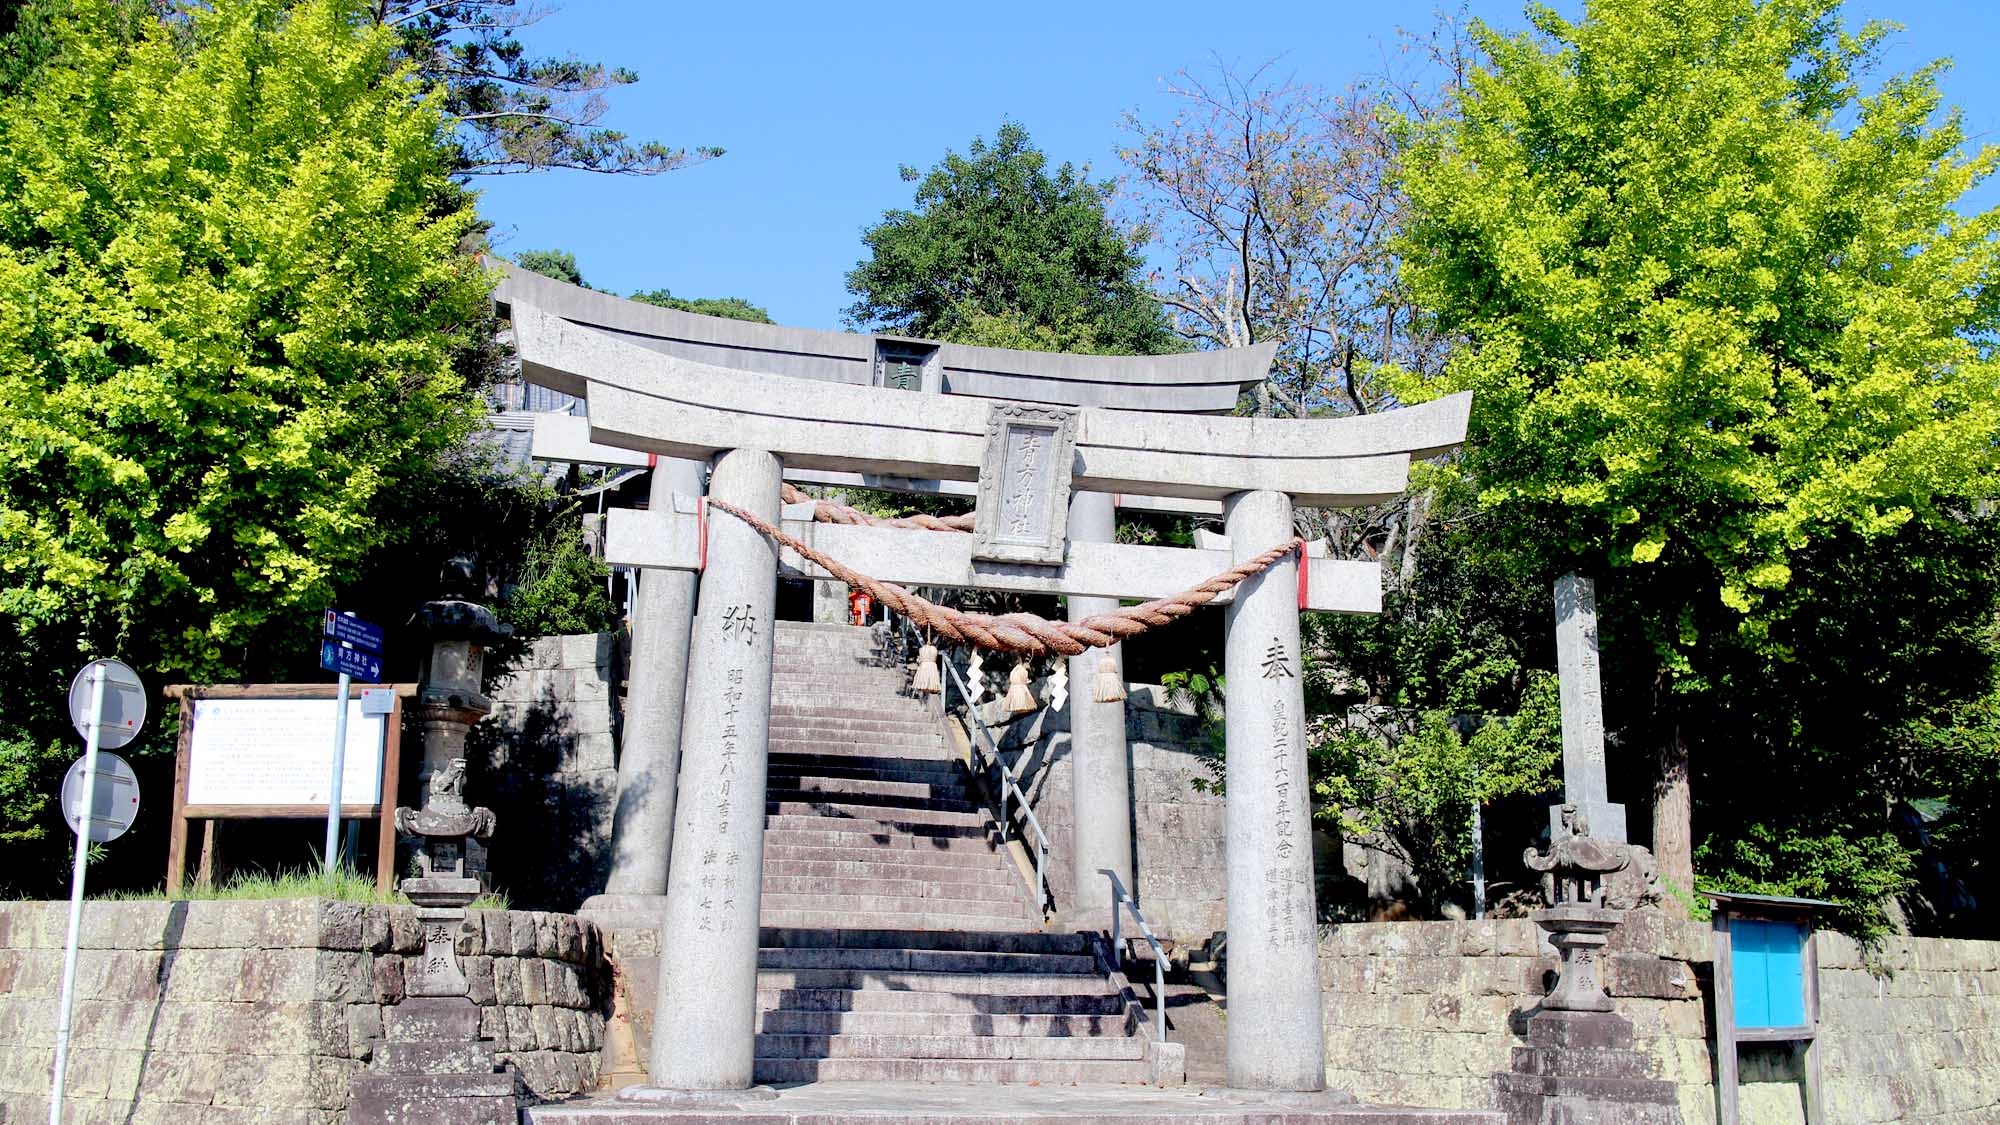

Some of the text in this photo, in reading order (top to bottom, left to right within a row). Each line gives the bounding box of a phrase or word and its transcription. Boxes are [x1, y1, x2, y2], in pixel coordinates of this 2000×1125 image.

[1010, 430, 1041, 534] 青方神社
[722, 604, 758, 646] 納
[1261, 636, 1295, 685] 奉
[718, 668, 743, 835] 昭和十五年八月吉日
[1272, 699, 1293, 859] 皇紀二千六百年記念
[427, 925, 452, 975] 奉納
[1576, 947, 1594, 993] 奉納
